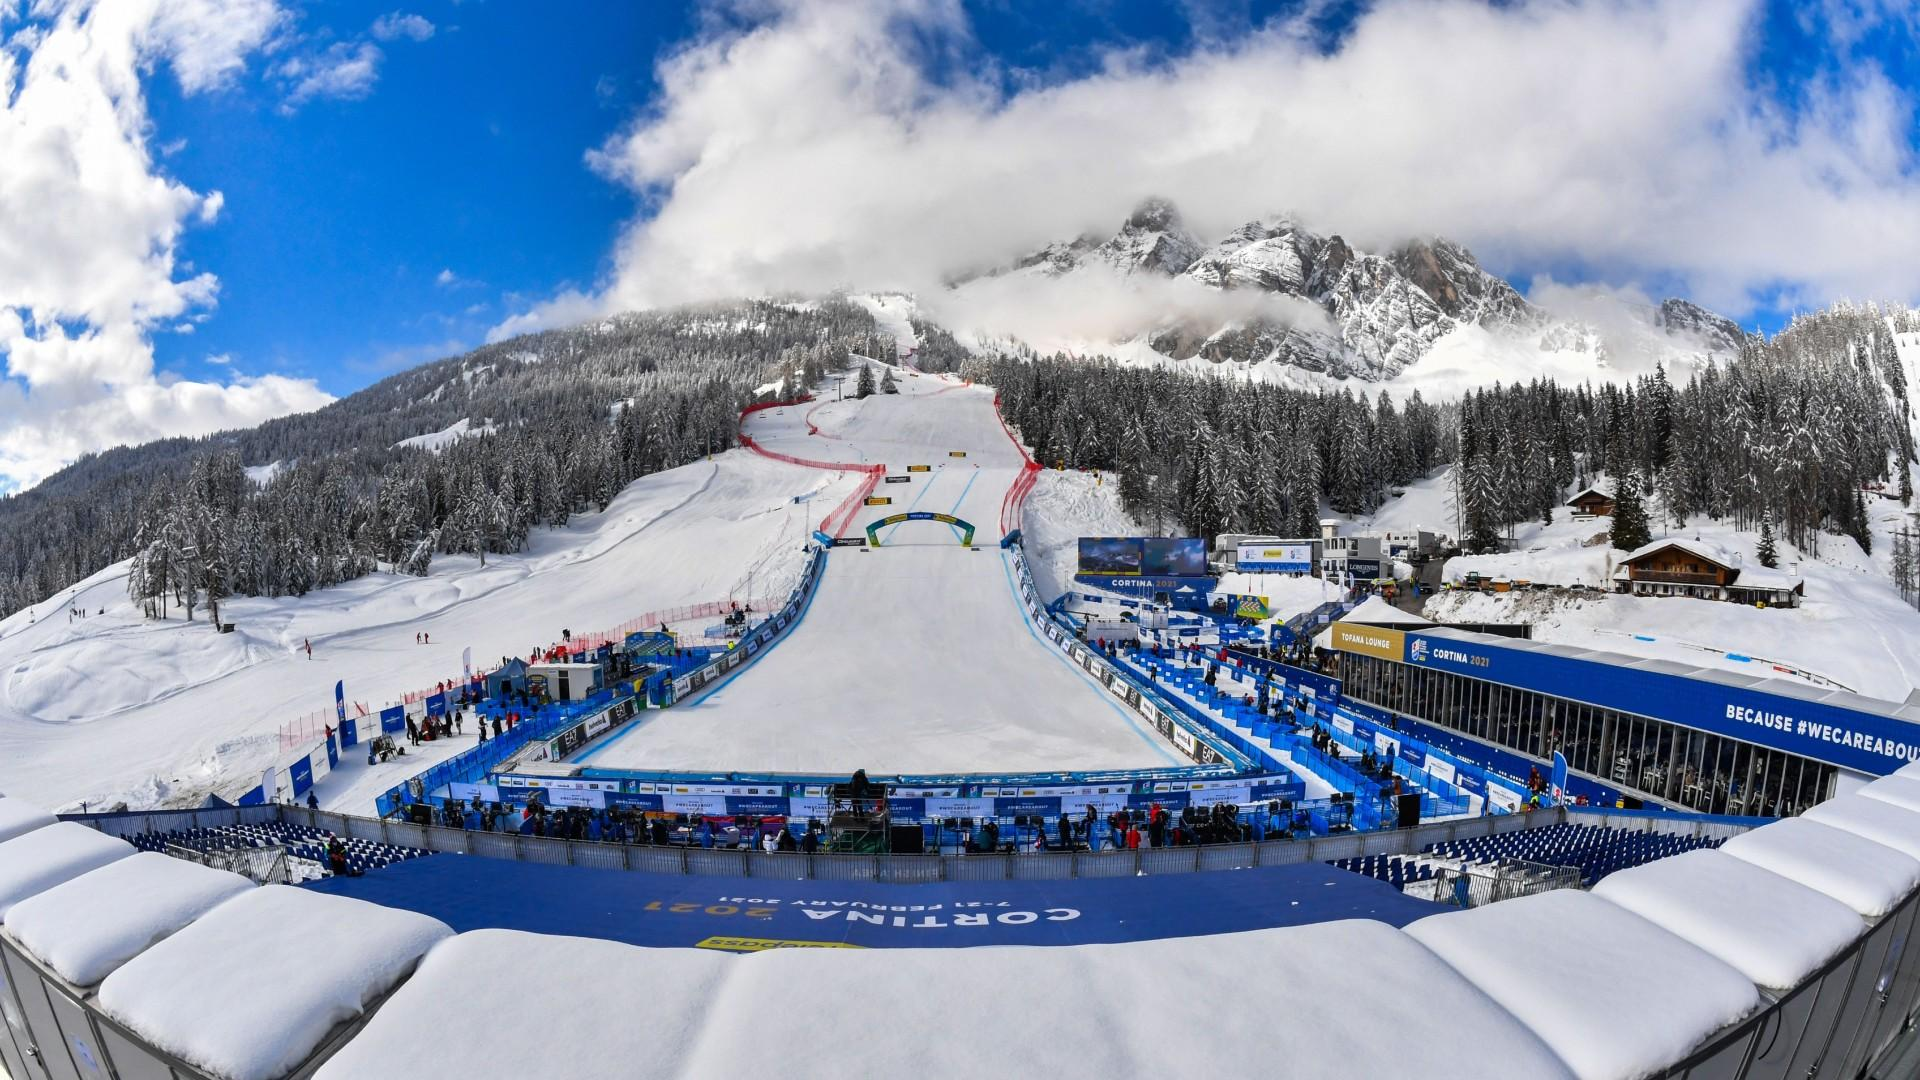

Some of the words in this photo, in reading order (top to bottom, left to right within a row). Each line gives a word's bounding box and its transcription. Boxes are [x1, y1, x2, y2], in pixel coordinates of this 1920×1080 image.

[1111, 579, 1153, 587] CORTINA
[1155, 580, 1177, 588] 2021
[1341, 632, 1365, 645] TOFANA
[1365, 637, 1391, 649] LOUNGE
[1433, 648, 1468, 664] CORTINA
[1470, 655, 1490, 667] 2021
[615, 703, 626, 717] EA7
[1725, 704, 1793, 732] BECAUSE
[588, 719, 603, 730] helvetia
[565, 728, 577, 745] EA7
[1202, 745, 1215, 763] EA7
[719, 896, 781, 904] 2021
[791, 899, 943, 912] FEBRUARY
[644, 901, 778, 918] 2021
[801, 908, 1081, 928] CORTINA
